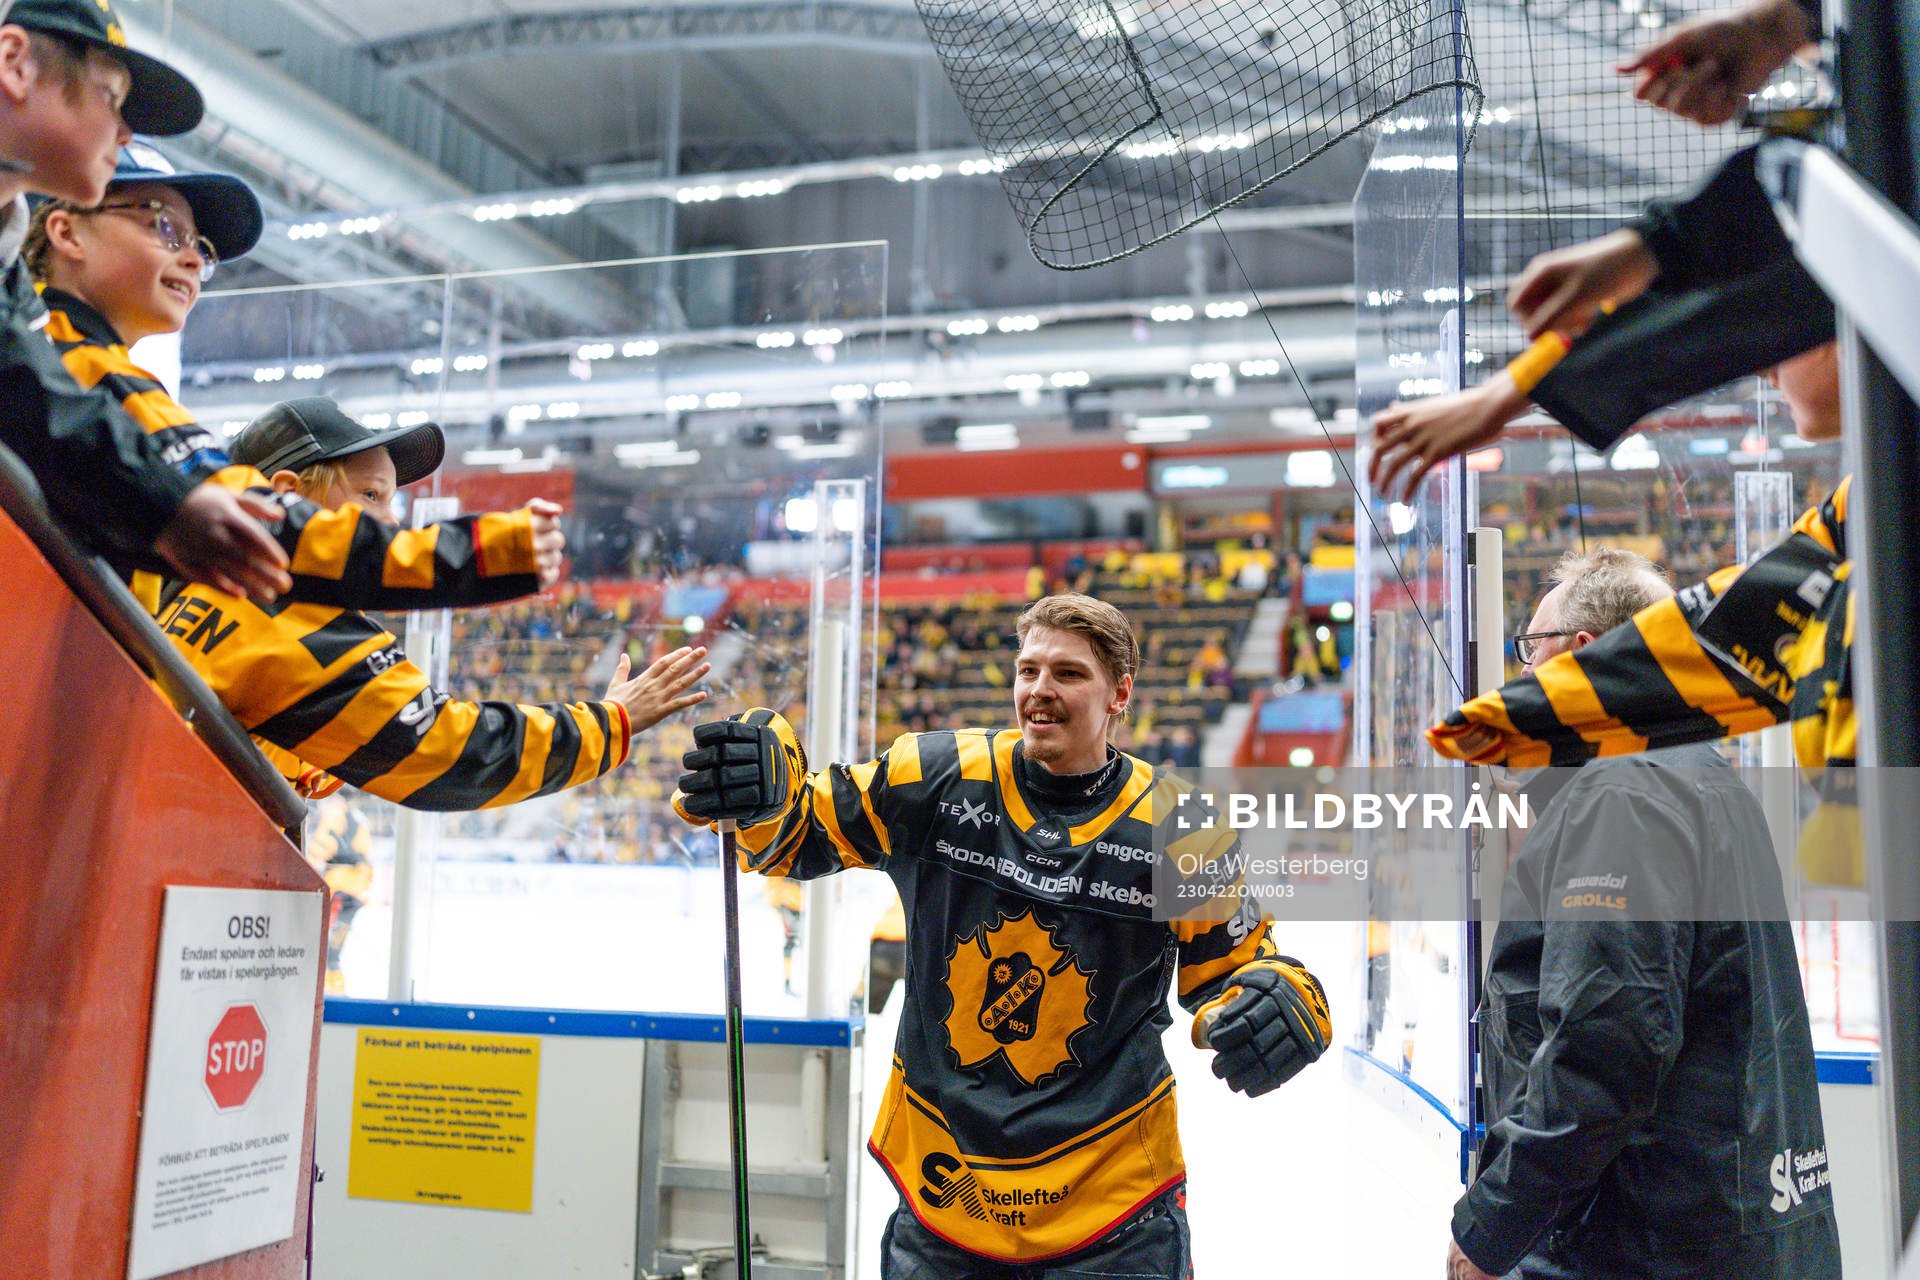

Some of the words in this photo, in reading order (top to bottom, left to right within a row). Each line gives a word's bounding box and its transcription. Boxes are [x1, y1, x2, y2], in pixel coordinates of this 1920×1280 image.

[939, 797, 1000, 830] TEXOR
[1036, 828, 1061, 840] SHL
[936, 839, 996, 870] ŠKODA
[1025, 854, 1061, 868] CCM
[1000, 859, 1084, 895] BOLIDEN
[1089, 881, 1158, 908] skebo
[228, 915, 271, 939] OBS!
[181, 946, 218, 961] Endast
[220, 946, 256, 962] spelare
[258, 946, 275, 959] och
[277, 945, 305, 959] ledare
[180, 966, 195, 981] får
[198, 966, 227, 980] vistas
[235, 964, 300, 982] spelargången.
[1008, 1019, 1029, 1034] 1921
[208, 1038, 264, 1076] STOP
